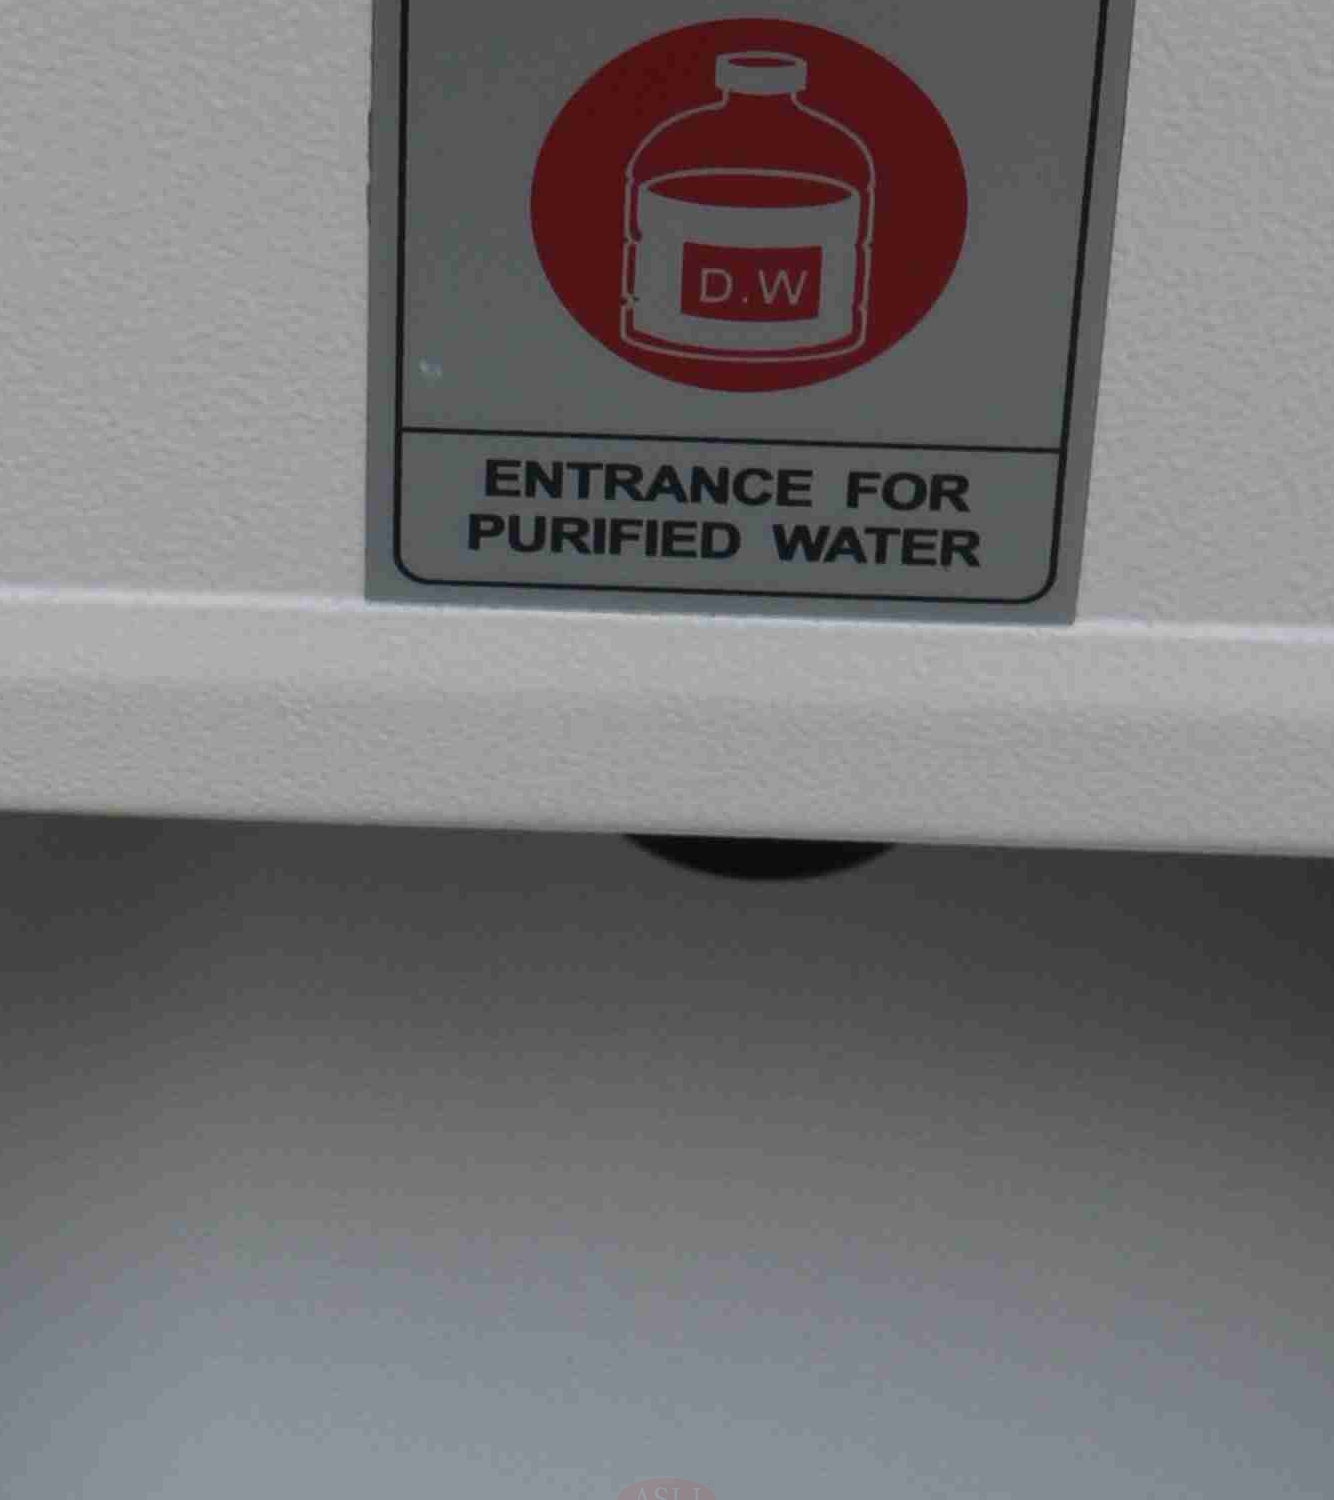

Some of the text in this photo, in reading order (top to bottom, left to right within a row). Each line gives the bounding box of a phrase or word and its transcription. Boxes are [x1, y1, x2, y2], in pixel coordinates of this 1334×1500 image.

[699, 267, 809, 306] D.W
[484, 458, 972, 513] ENTRANCE FOR
[467, 512, 981, 568] PURIFIED WATER
